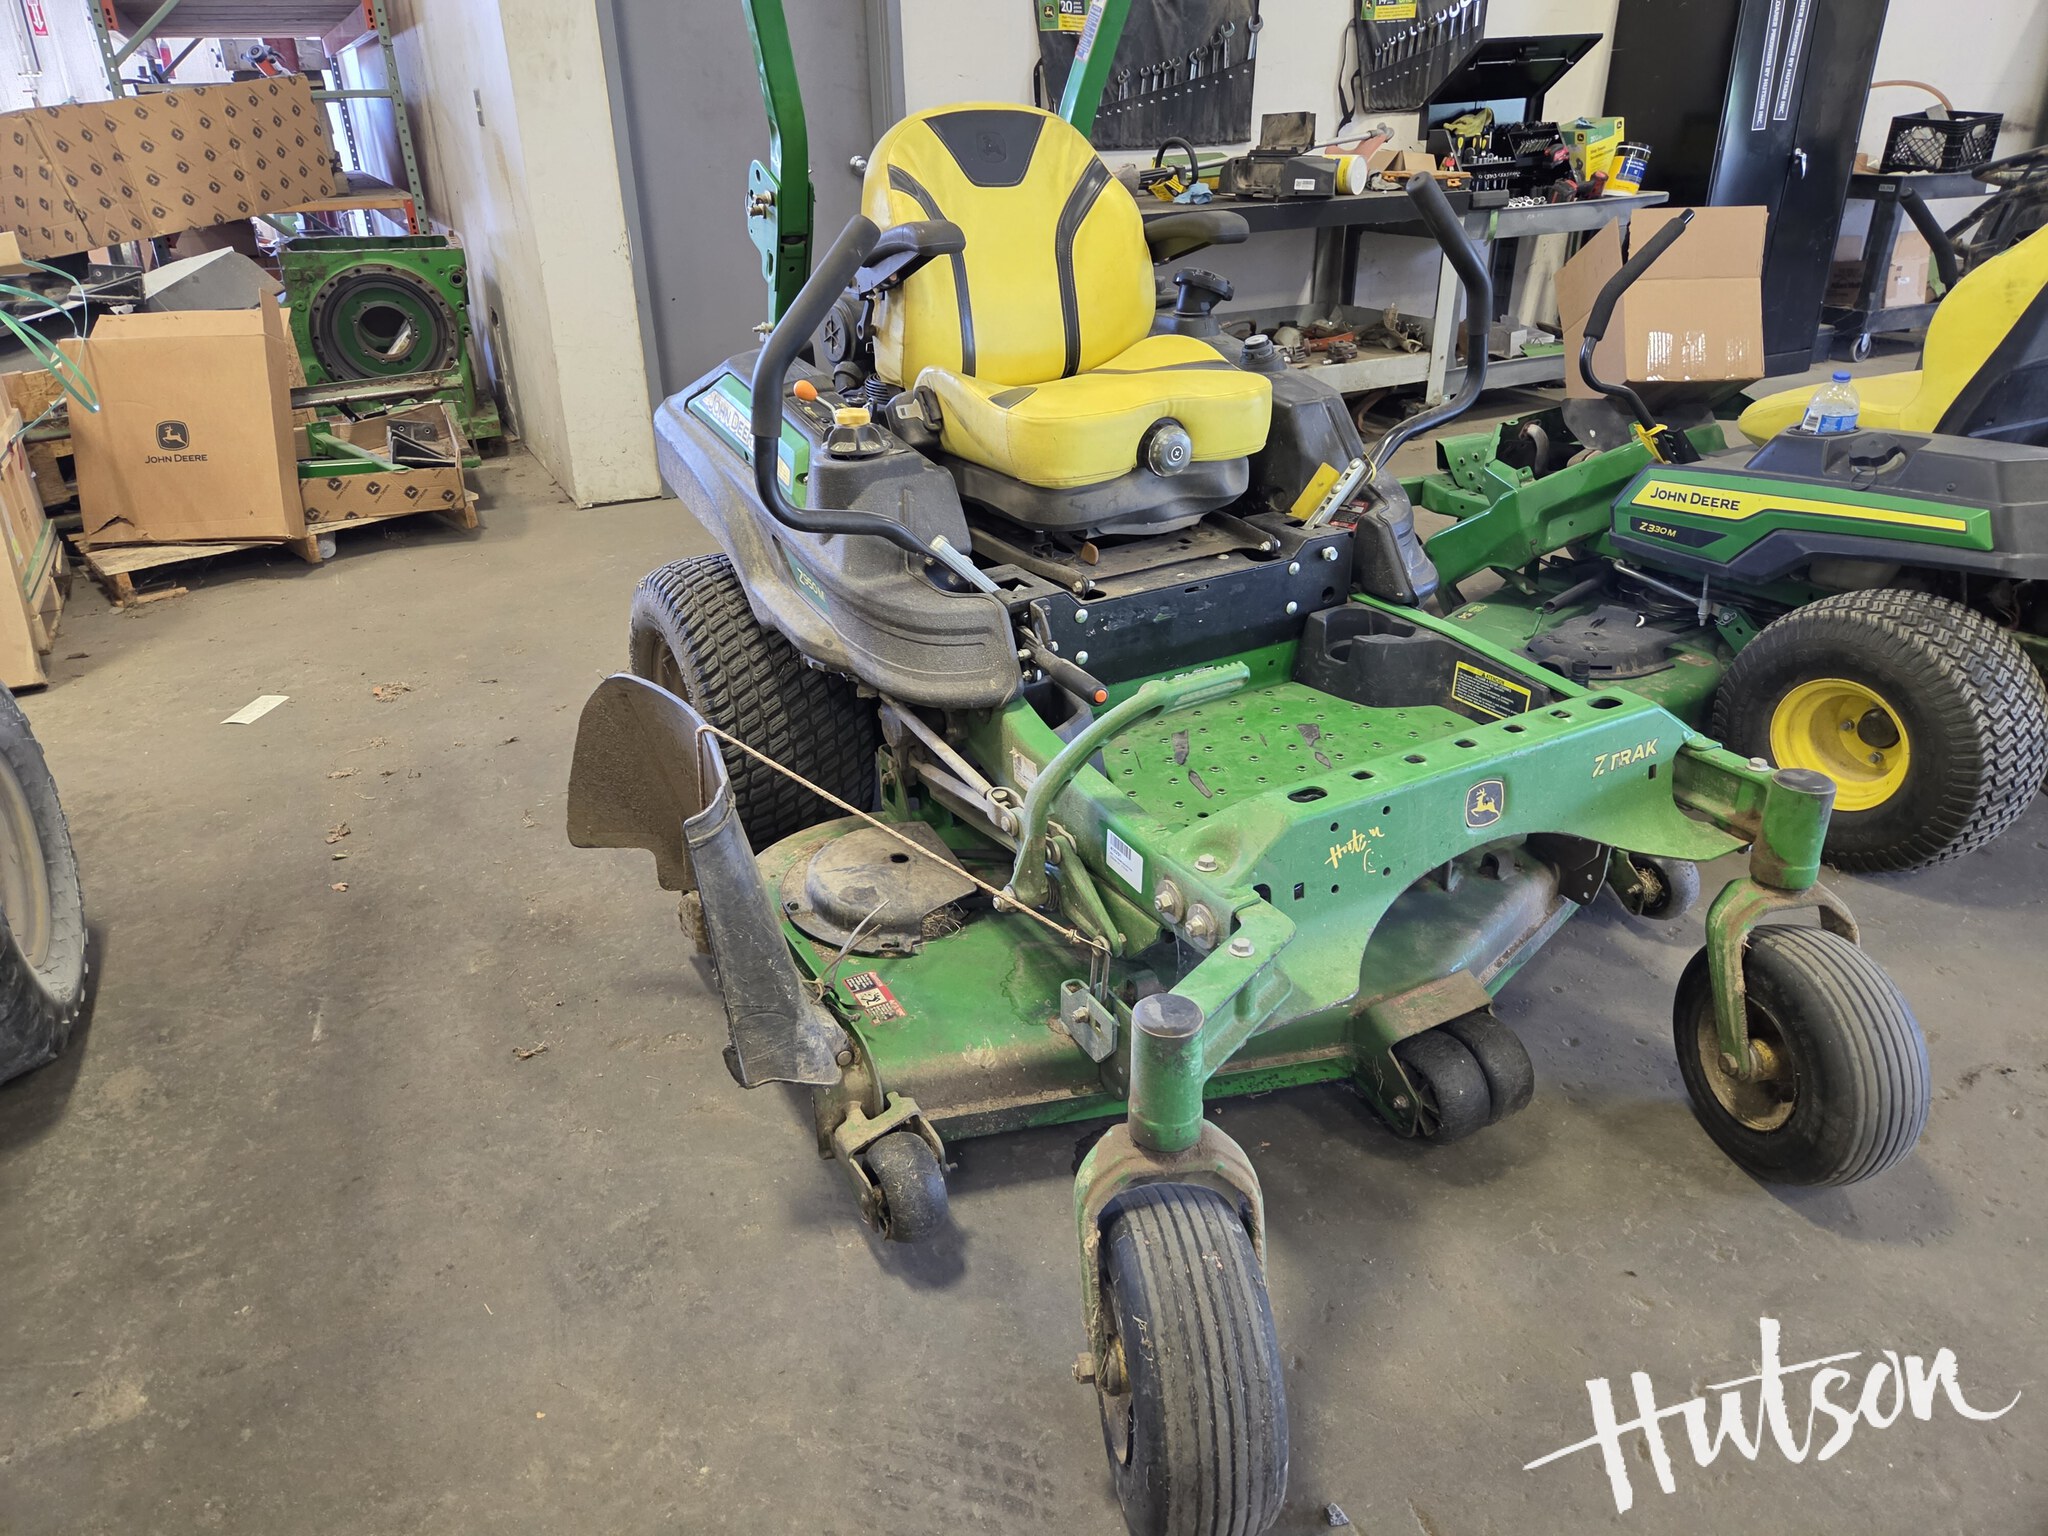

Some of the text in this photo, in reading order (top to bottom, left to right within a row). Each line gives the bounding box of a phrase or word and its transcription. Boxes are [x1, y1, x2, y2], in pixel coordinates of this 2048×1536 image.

[1060, 0, 1073, 13] 20
[1760, 78, 1769, 110] HUTSON
[1781, 68, 1793, 100] HUTSON
[708, 395, 754, 449] JOHN DEER
[145, 454, 208, 464] JOHN DEERE
[1650, 487, 1741, 511] JOHN DEERE
[1639, 521, 1677, 537] Z330M
[1592, 737, 1659, 778] Z TRAK
